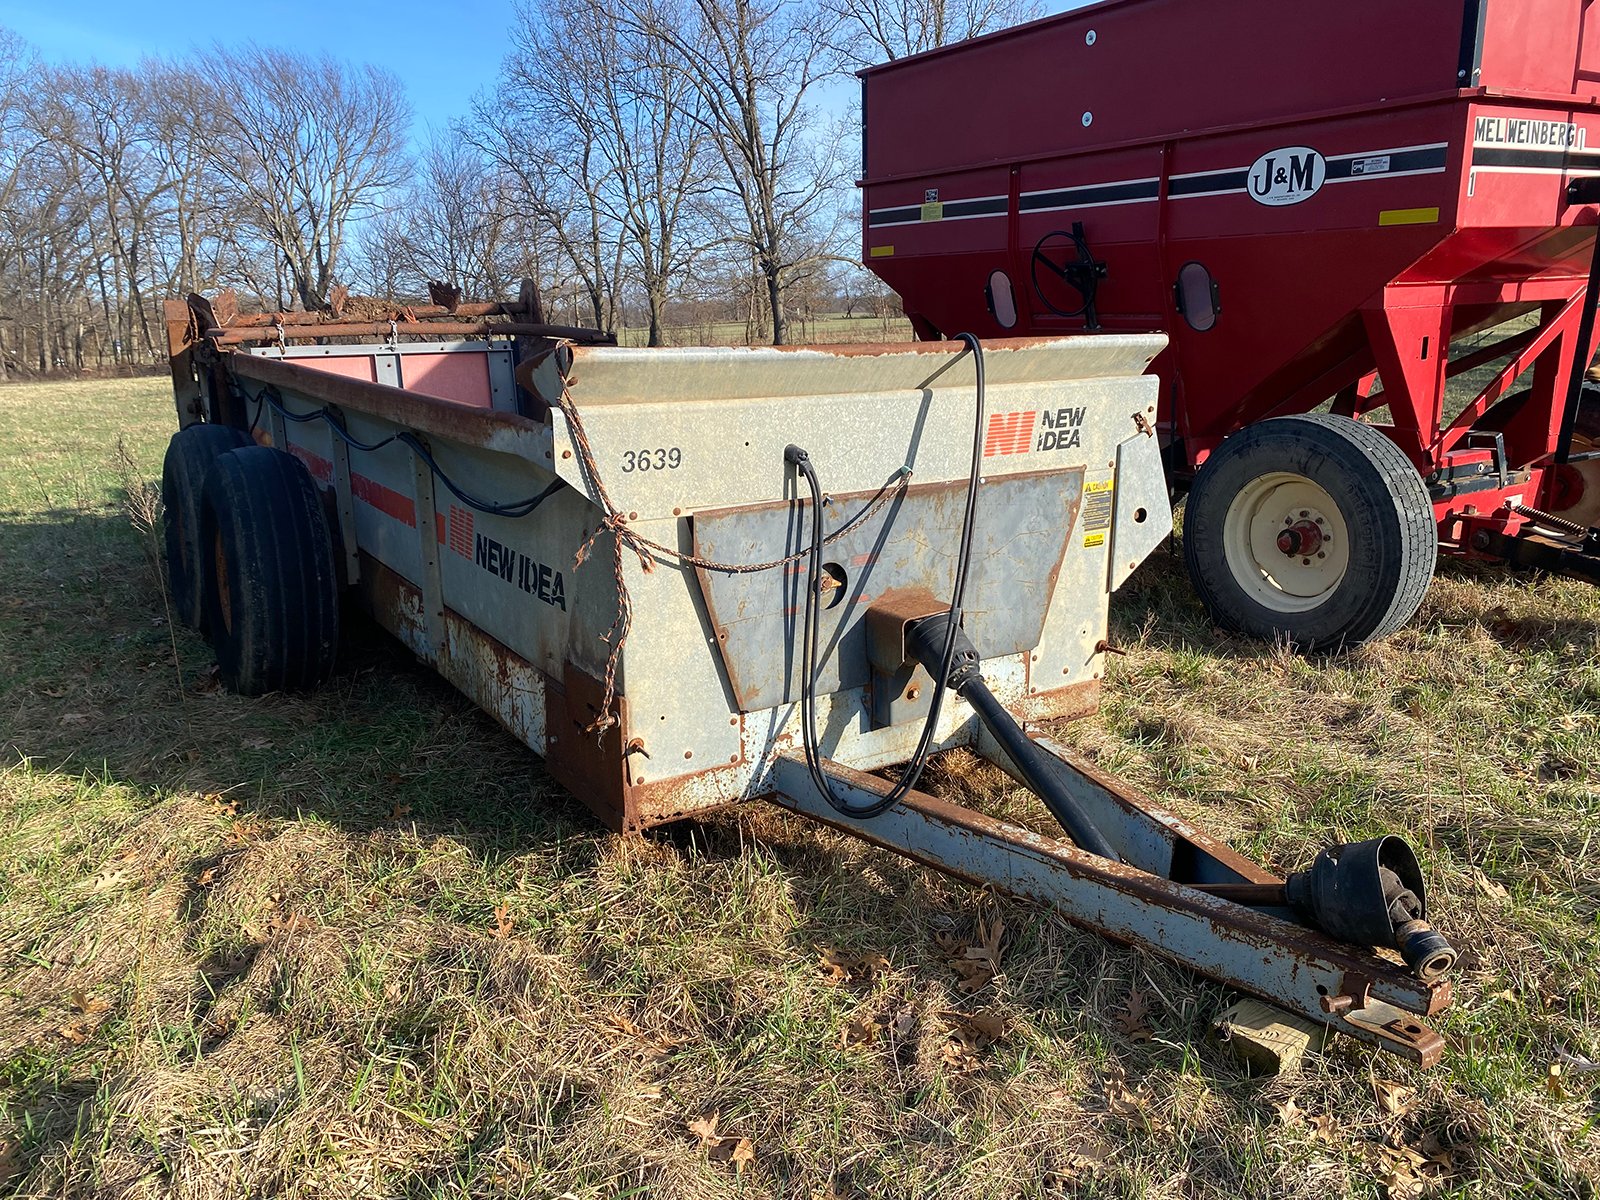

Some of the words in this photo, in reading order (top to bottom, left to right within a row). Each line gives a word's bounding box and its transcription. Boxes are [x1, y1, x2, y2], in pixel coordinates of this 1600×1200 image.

[1475, 118, 1504, 142] MEL
[1507, 119, 1576, 147] WEINBERG
[1253, 153, 1317, 196] J&M
[1042, 407, 1087, 429] NEW
[1037, 429, 1080, 451] IDEA
[621, 447, 681, 473] 3639
[476, 532, 516, 584] NEW
[518, 554, 567, 613] IDEA
